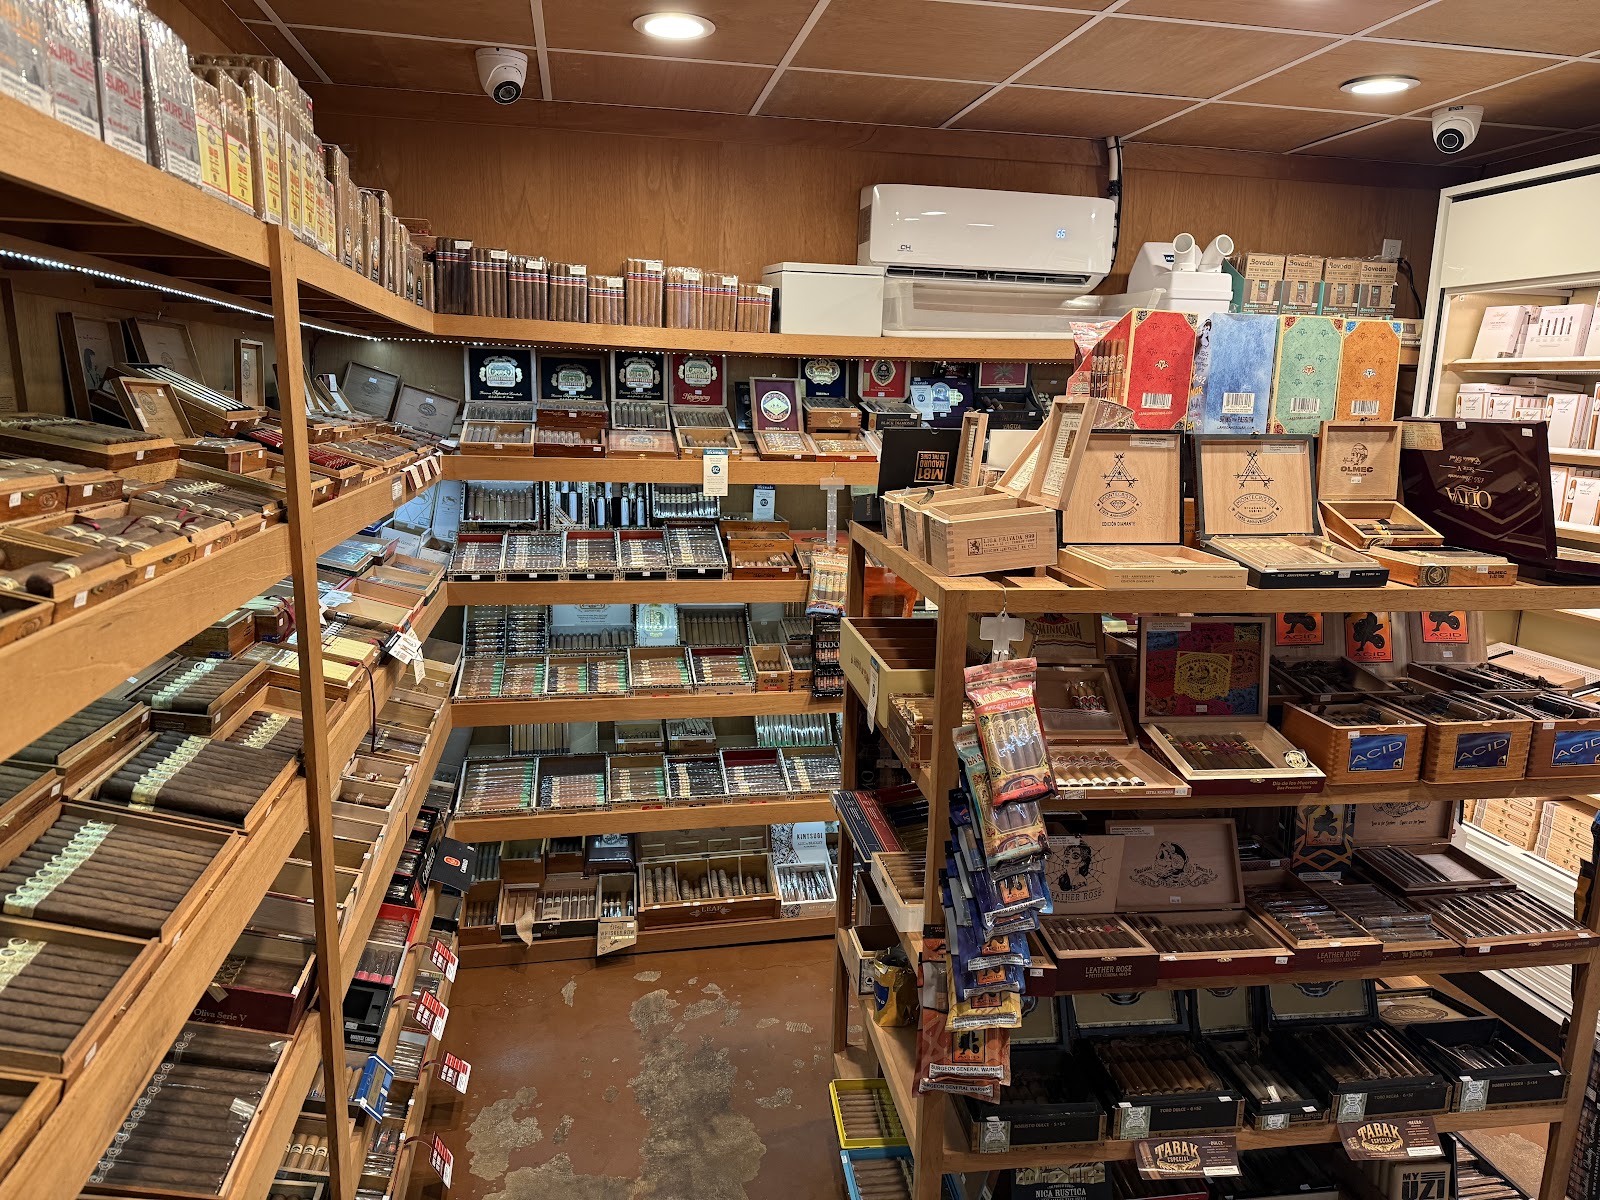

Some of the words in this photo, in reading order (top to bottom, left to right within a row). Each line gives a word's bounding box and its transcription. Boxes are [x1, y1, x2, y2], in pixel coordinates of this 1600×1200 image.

[1056, 229, 1066, 239] 66
[919, 459, 945, 468] MADURO
[918, 468, 944, 481] M81
[1444, 486, 1492, 510] OLIVA
[815, 641, 840, 649] PERDO
[814, 668, 844, 676] PERDOM
[1352, 740, 1403, 766] ACID
[1457, 738, 1508, 763] ACID
[796, 832, 823, 840] KINTSUGI
[1051, 890, 1081, 901] EATHER
[1083, 889, 1102, 900] ROSE
[1317, 951, 1345, 960] LEATHER
[1345, 950, 1361, 958] ROSE
[1085, 965, 1115, 975] LEATHER
[1115, 964, 1133, 974] ROSE
[193, 1007, 215, 1020] Oliva
[217, 1010, 238, 1021] Serie
[238, 1013, 248, 1022] V
[930, 1064, 956, 1073] SURGEON
[1357, 1122, 1401, 1141] TABAK
[1154, 1140, 1200, 1159] TABAK
[1402, 1172, 1420, 1181] MY
[1035, 1188, 1054, 1198] NICA
[1055, 1187, 1087, 1196] RUSTICA
[1401, 1179, 1445, 1200] UZI
